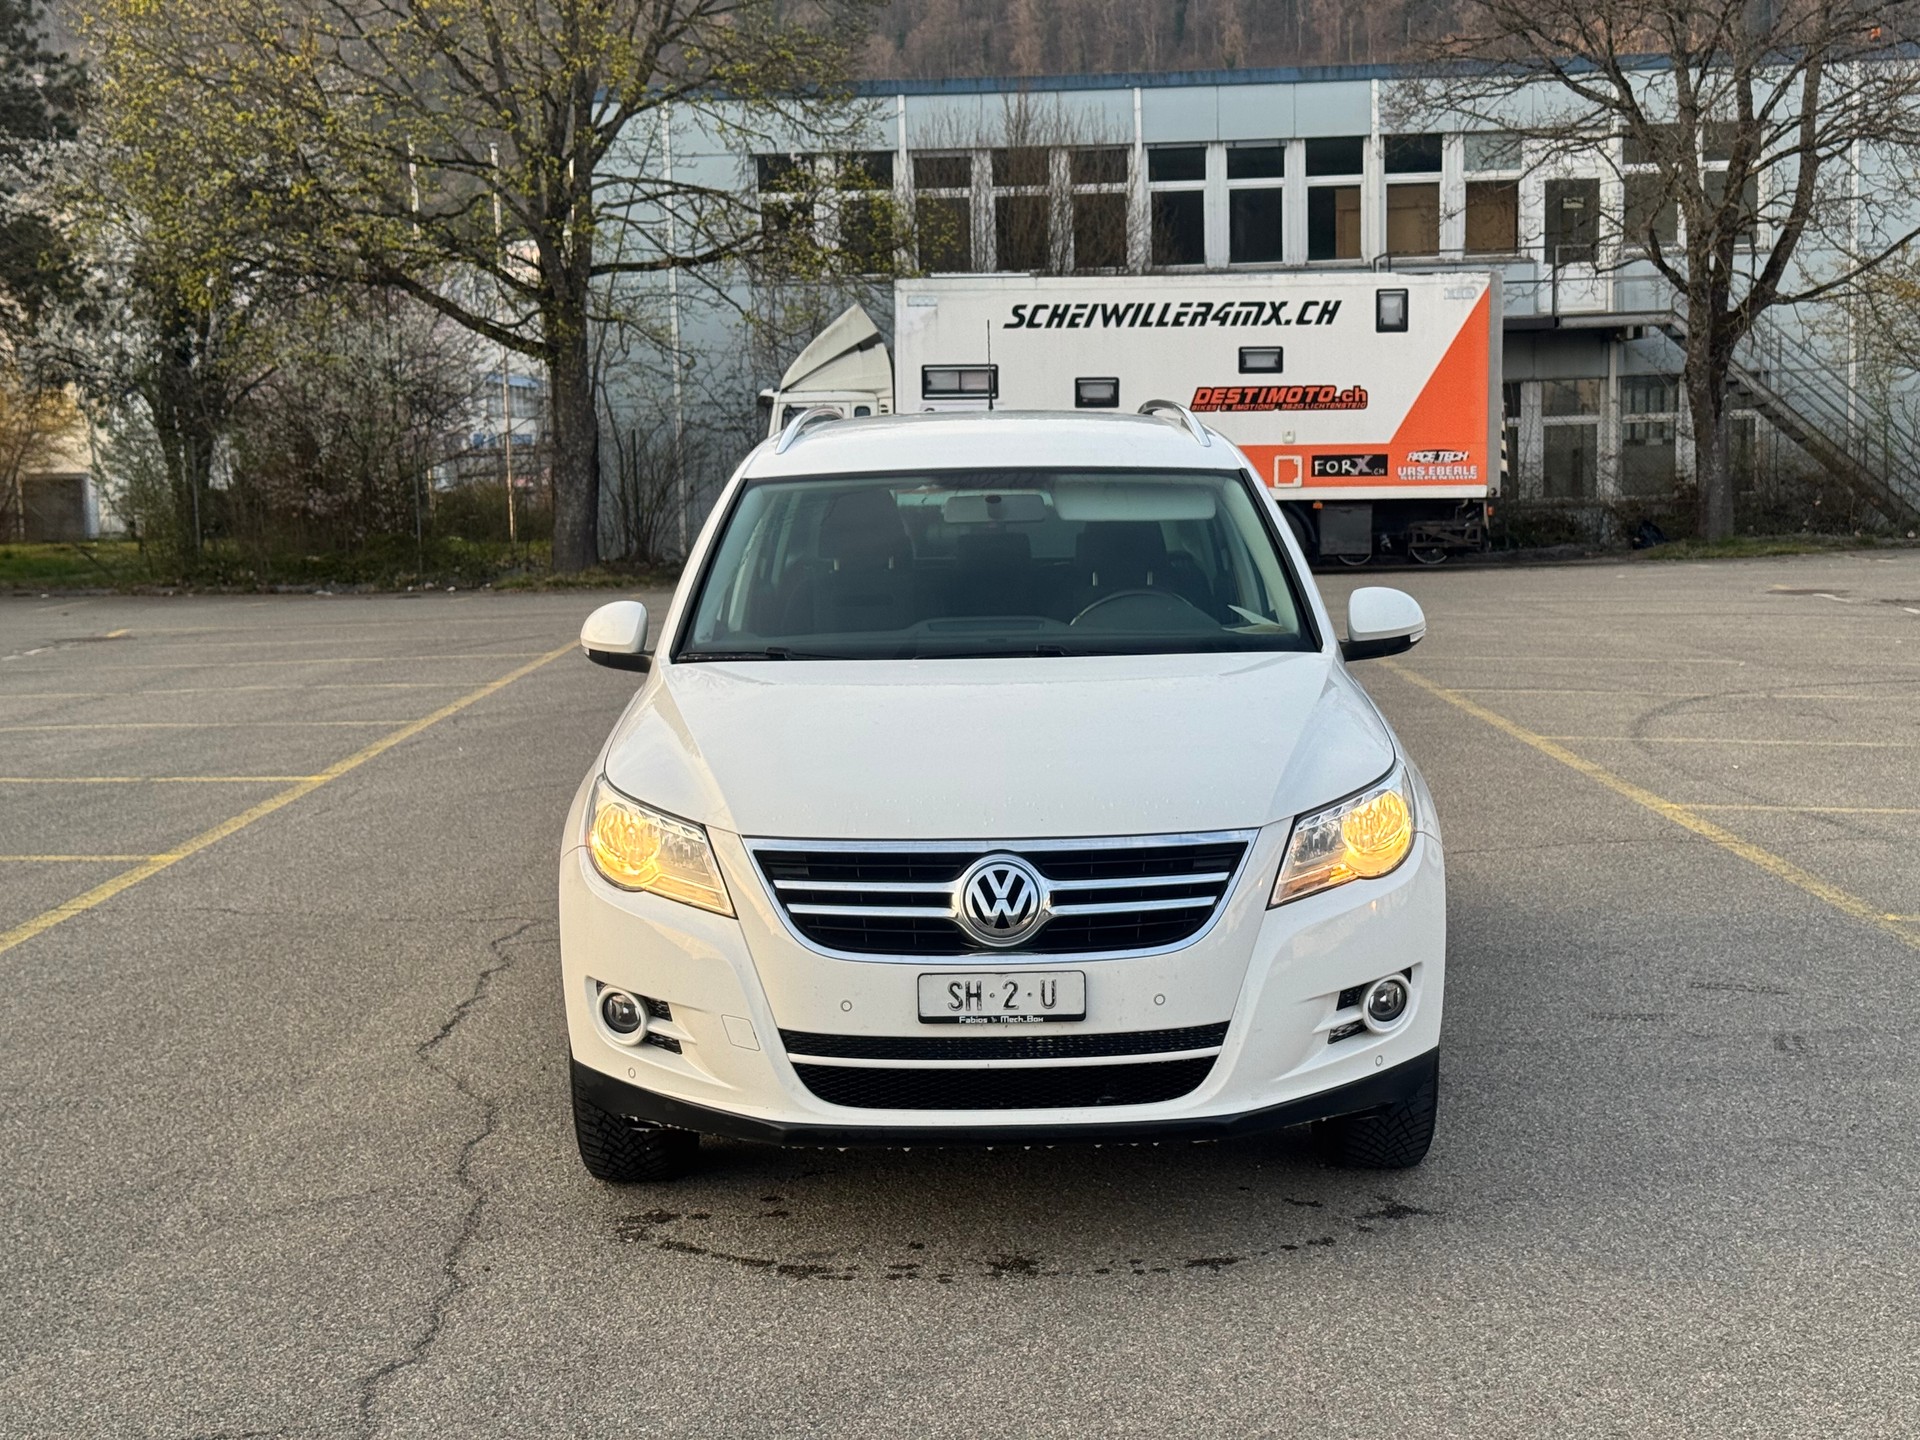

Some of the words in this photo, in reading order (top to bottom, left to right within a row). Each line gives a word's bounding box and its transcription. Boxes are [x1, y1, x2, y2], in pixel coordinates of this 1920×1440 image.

[1003, 299, 1342, 329] SCHEIWILLER4MX.CH
[1192, 385, 1368, 405] DESTIMOTO.ch
[1231, 403, 1275, 411] EMOTIONS
[1436, 451, 1469, 463] TECH
[1397, 465, 1425, 476] URS
[1428, 465, 1478, 476] EBERLE
[968, 866, 1036, 933] VW
[947, 980, 982, 1011] SH
[1002, 979, 1020, 1010] 2
[1040, 979, 1057, 1009] U
[958, 1016, 988, 1024] Fabios
